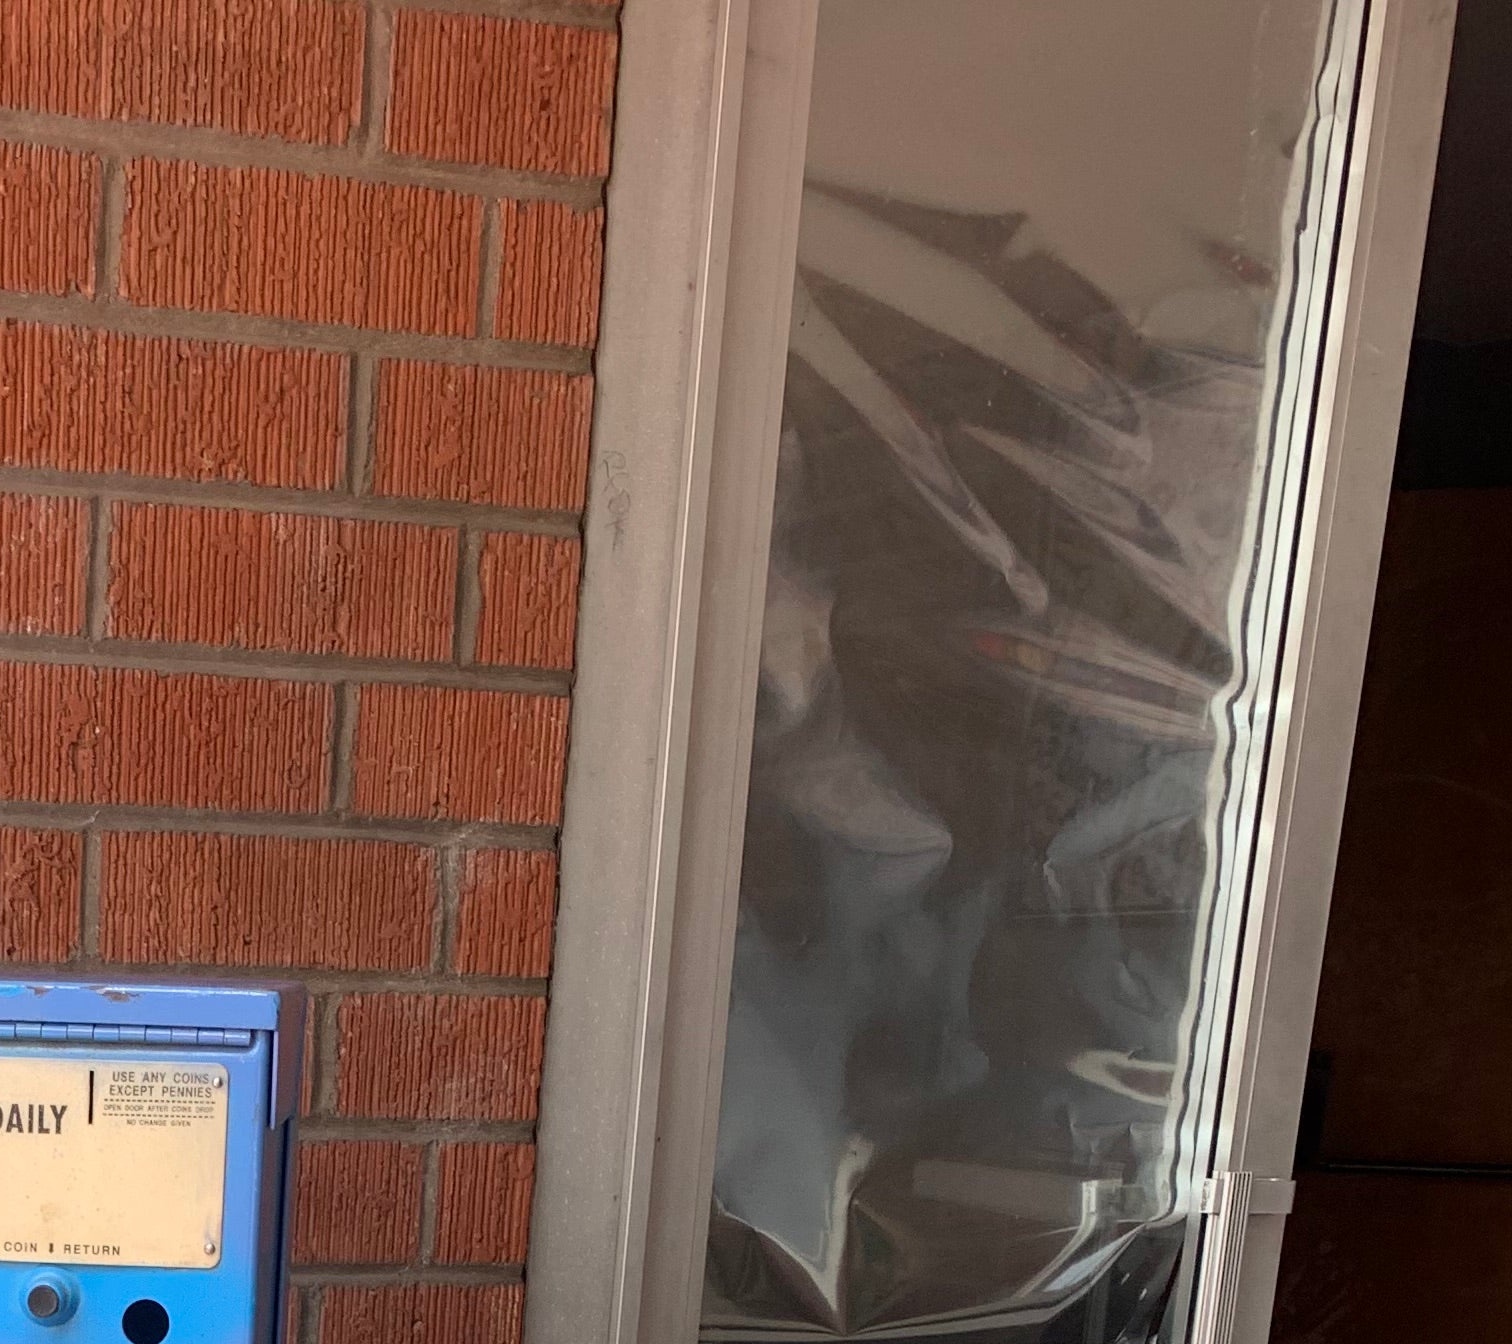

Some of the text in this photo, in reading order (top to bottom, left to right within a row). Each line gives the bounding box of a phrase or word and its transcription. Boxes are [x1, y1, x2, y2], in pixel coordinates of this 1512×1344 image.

[112, 1071, 209, 1085] USE ANY COINS
[109, 1085, 213, 1098] EXCEPT PENNIES
[148, 1105, 168, 1113] AFTER
[3, 1241, 121, 1256] COIN RETURN
